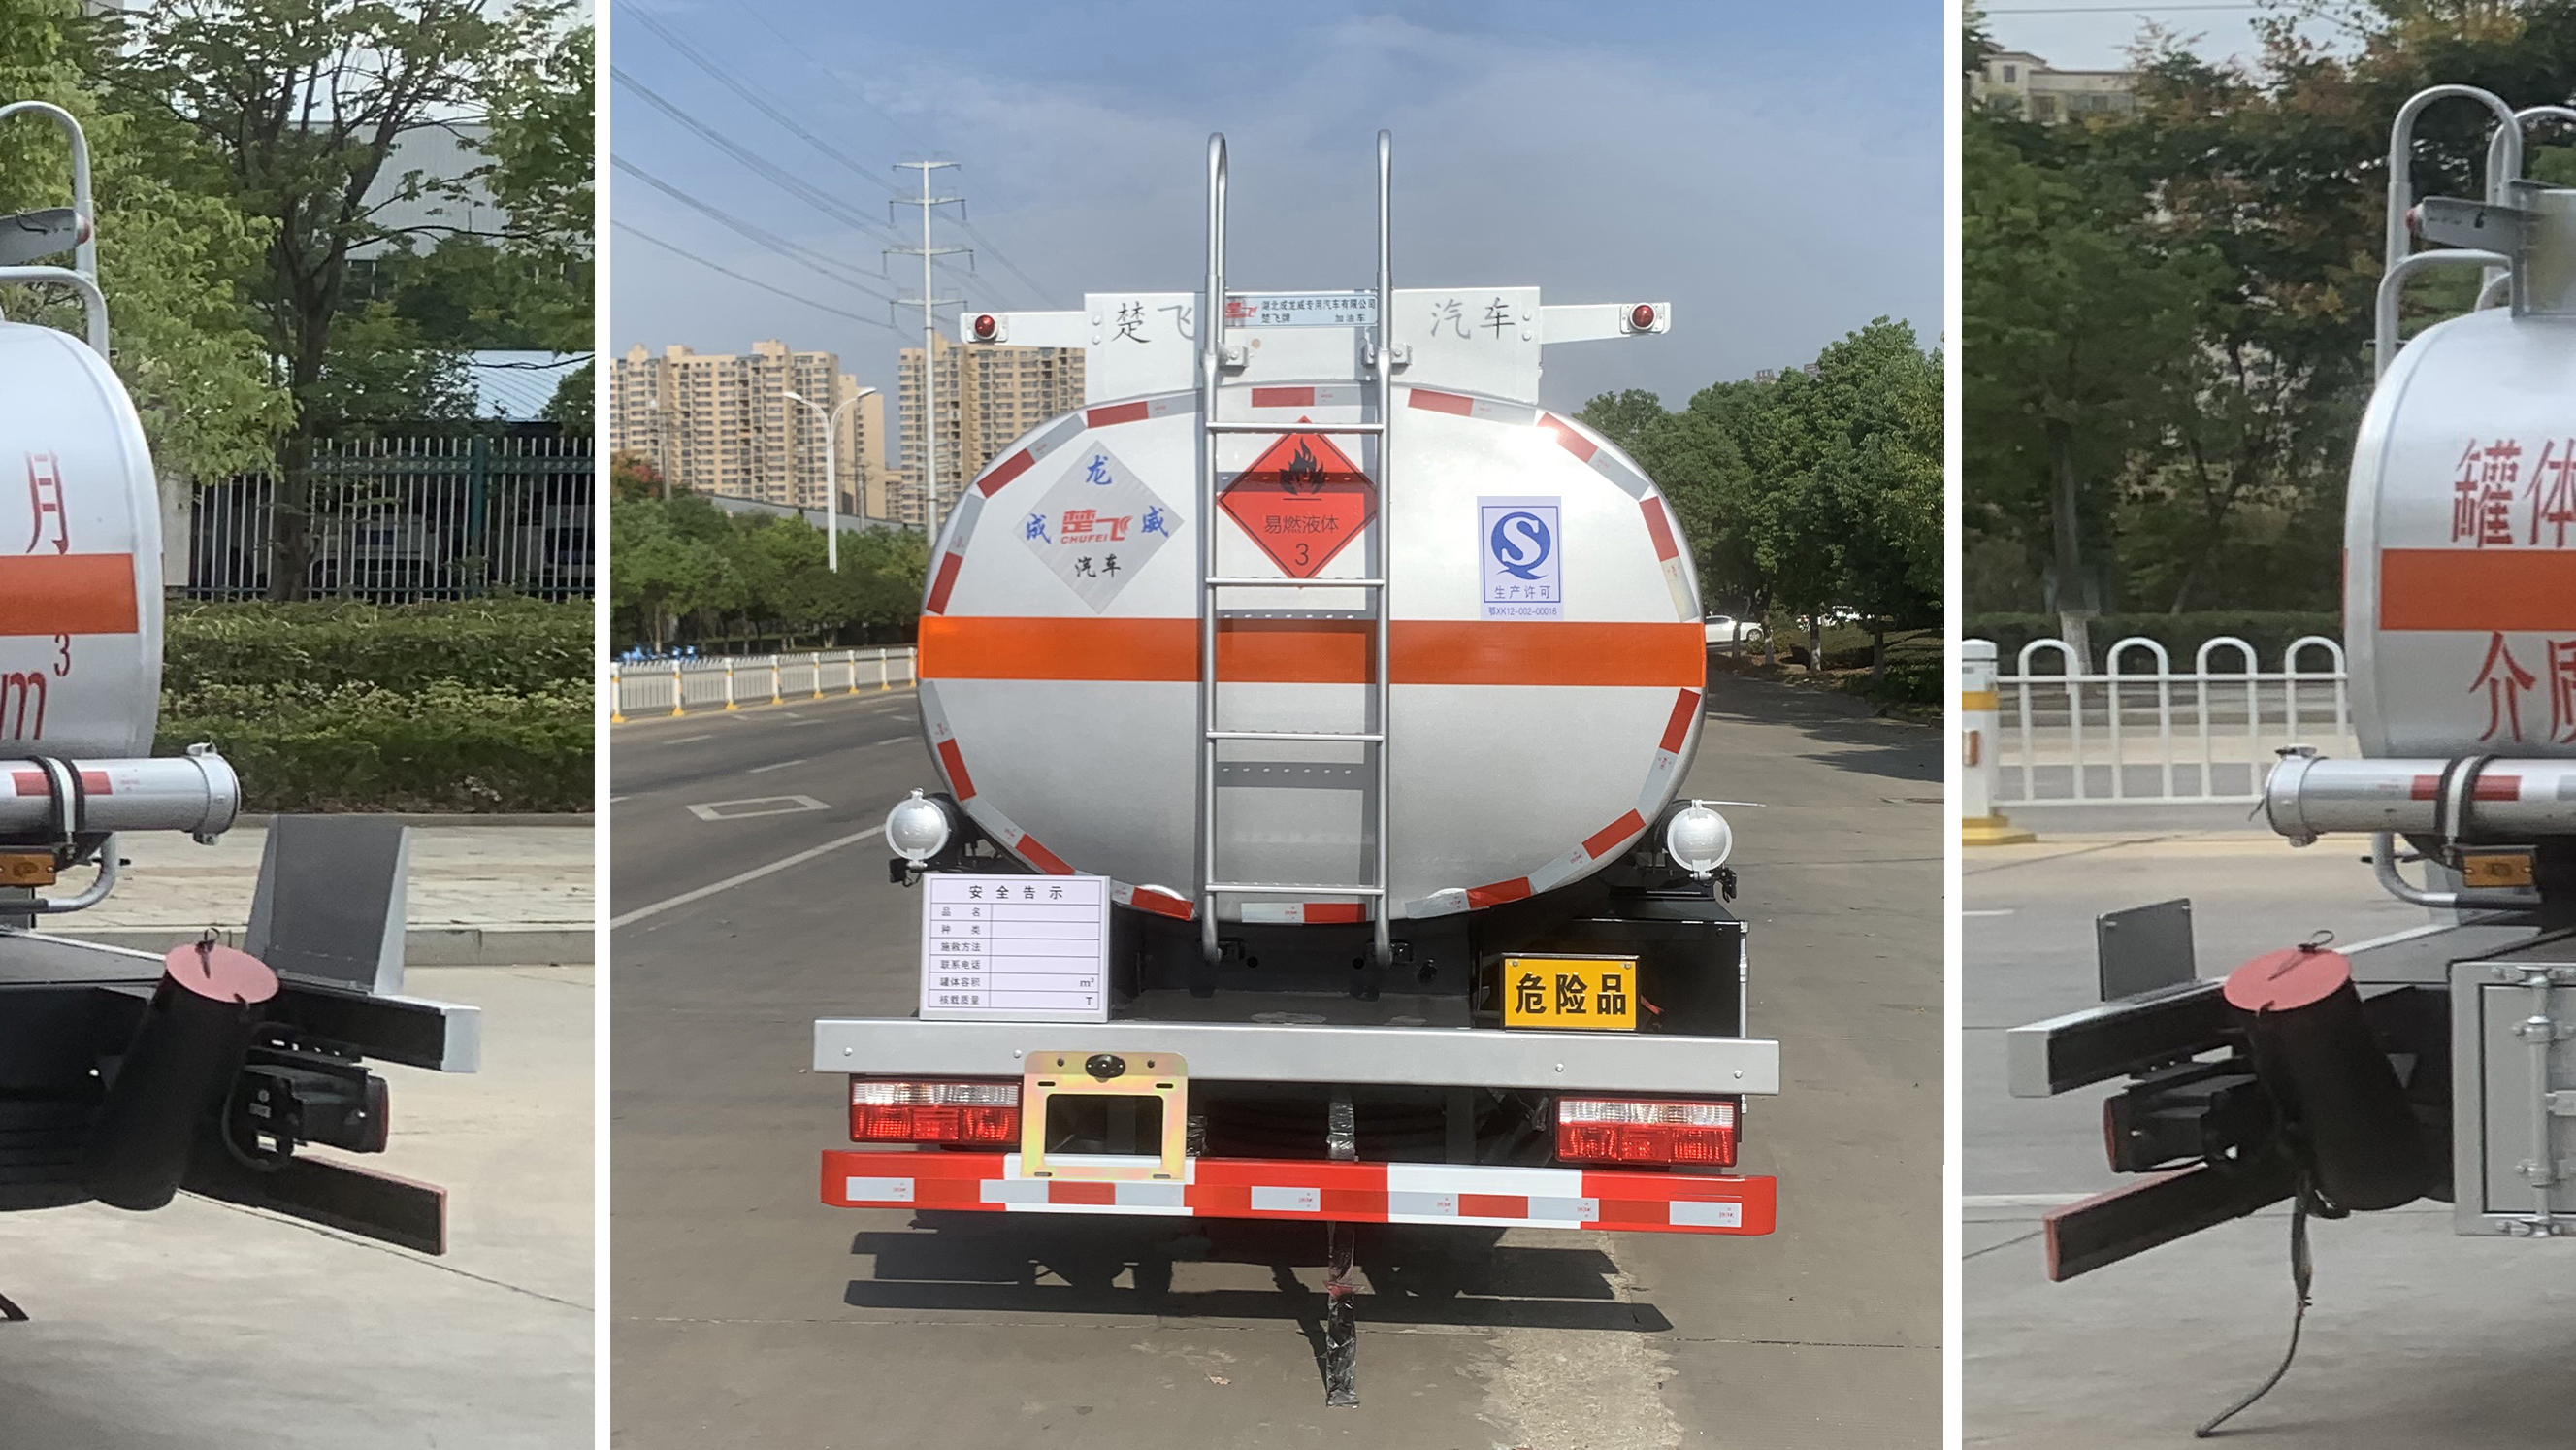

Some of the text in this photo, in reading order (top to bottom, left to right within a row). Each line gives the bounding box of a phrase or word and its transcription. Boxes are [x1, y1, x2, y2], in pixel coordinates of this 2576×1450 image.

[1261, 298, 1376, 311] 湖北成龙威专用汽车有限公司
[1112, 300, 1195, 344] 楚飞
[1261, 313, 1291, 324] 楚飞牌
[1334, 313, 1366, 323] 加油车
[1430, 297, 1516, 340] 汽车
[1085, 454, 1113, 486] 龙
[25, 449, 70, 555] 月
[1026, 512, 1052, 544] 成
[1141, 505, 1169, 539] 威
[1263, 514, 1340, 534] 易燃液体
[1060, 534, 1108, 544] CHUFEI
[1294, 543, 1309, 566] 3
[1074, 553, 1121, 577] 汽车
[1494, 585, 1551, 600] 生产许可
[969, 884, 1063, 900] 安全告示
[940, 941, 982, 953] 施救方法
[939, 959, 982, 971] 联系电话
[939, 976, 981, 988] 罐体容积
[939, 995, 981, 1005] 核载质量
[1085, 996, 1093, 1006] T
[1515, 972, 1626, 1015] 危险品
